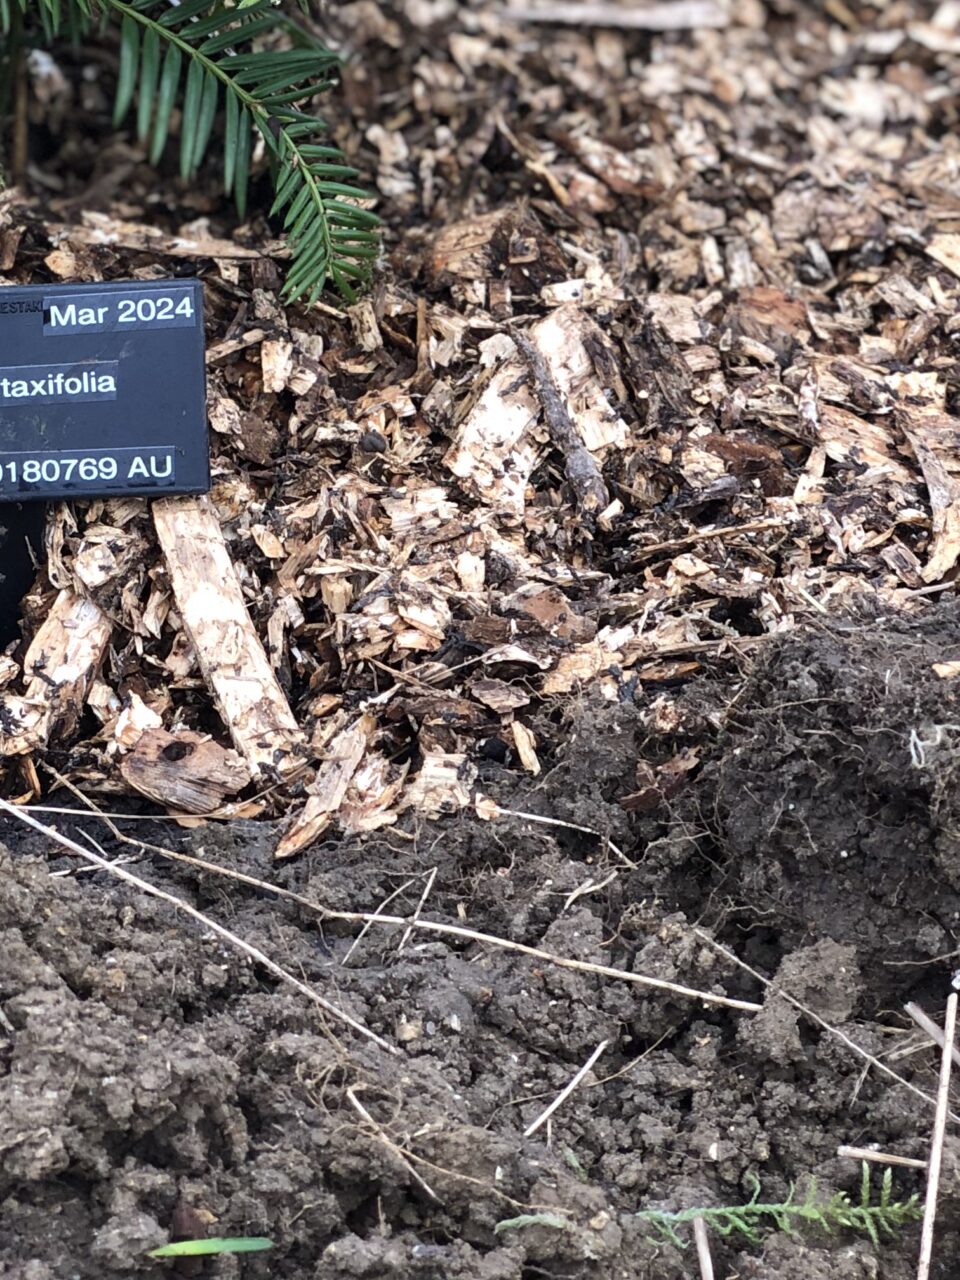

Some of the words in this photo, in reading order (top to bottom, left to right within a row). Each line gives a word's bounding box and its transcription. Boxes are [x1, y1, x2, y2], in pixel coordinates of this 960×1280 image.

[49, 304, 109, 327] Mar
[116, 296, 194, 323] 2024
[0, 371, 117, 399] taxifolia
[126, 455, 173, 479] AU
